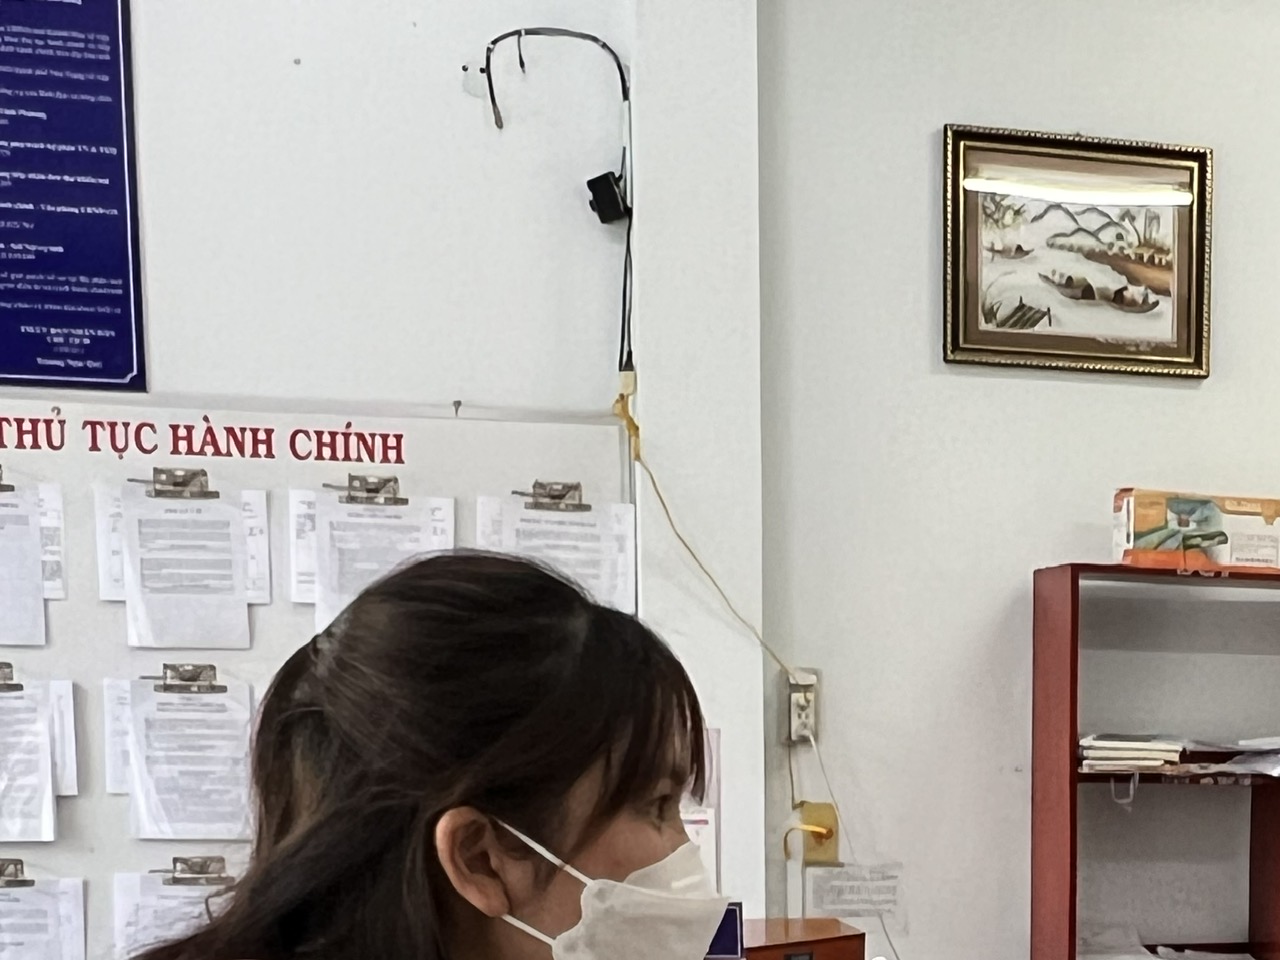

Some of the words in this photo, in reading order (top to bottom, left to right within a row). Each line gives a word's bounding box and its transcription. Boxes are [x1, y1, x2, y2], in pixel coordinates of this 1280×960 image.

[82, 420, 158, 460] TỤC
[169, 414, 276, 459] HÀNH
[289, 421, 405, 464] CHÍNH
